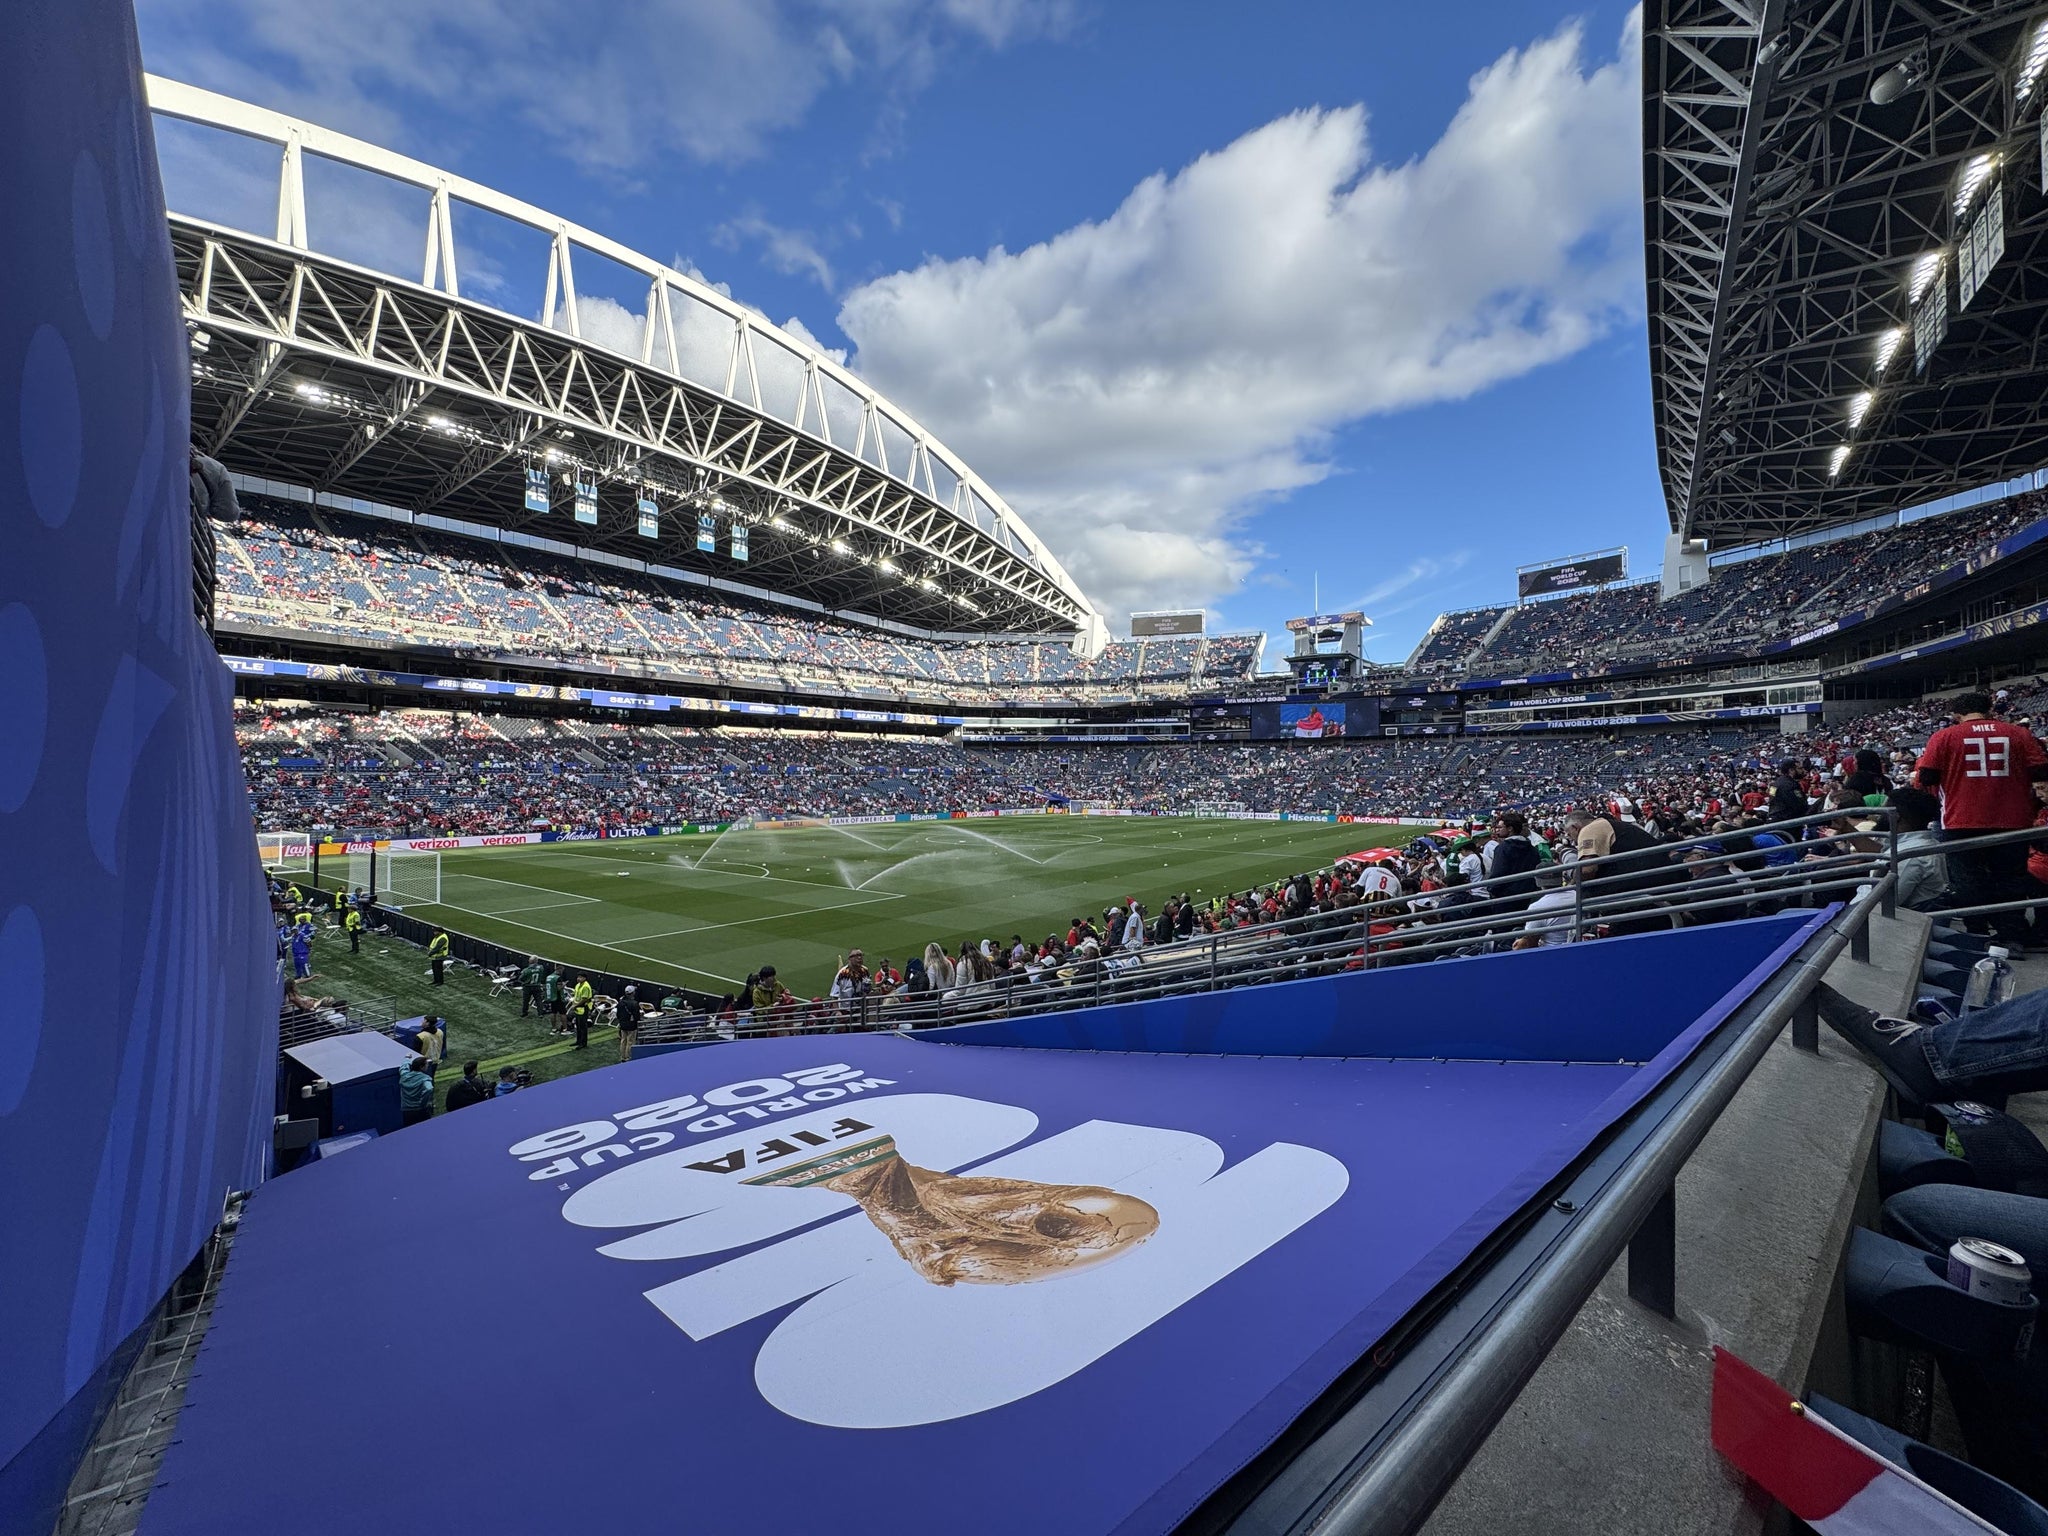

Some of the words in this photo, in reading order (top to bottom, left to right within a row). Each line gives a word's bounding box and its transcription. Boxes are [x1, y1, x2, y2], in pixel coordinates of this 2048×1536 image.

[1550, 573, 1573, 581] WORLD
[1557, 577, 1580, 585] 2026
[1904, 582, 1930, 601] SEATTLE
[1656, 657, 1694, 668] SEATTLE
[609, 696, 655, 706] SEATTLE
[856, 712, 887, 721] SEATTLE
[1740, 704, 1806, 717] SEATTLE
[1972, 724, 1996, 732] MIKE
[1963, 737, 2010, 777] 33
[1288, 814, 1328, 822] Hisense
[1353, 816, 1398, 824] McDonald's
[482, 835, 526, 846] verizon
[556, 830, 599, 842] Michelob
[609, 828, 647, 838] ULTRA
[345, 841, 372, 853] Lay's
[409, 838, 459, 850] verizon
[1379, 876, 1387, 889] 8
[686, 1077, 898, 1133] WORLD
[508, 1063, 865, 1162] 2026
[681, 1118, 875, 1175] FIFA
[528, 1131, 676, 1181] CUP
